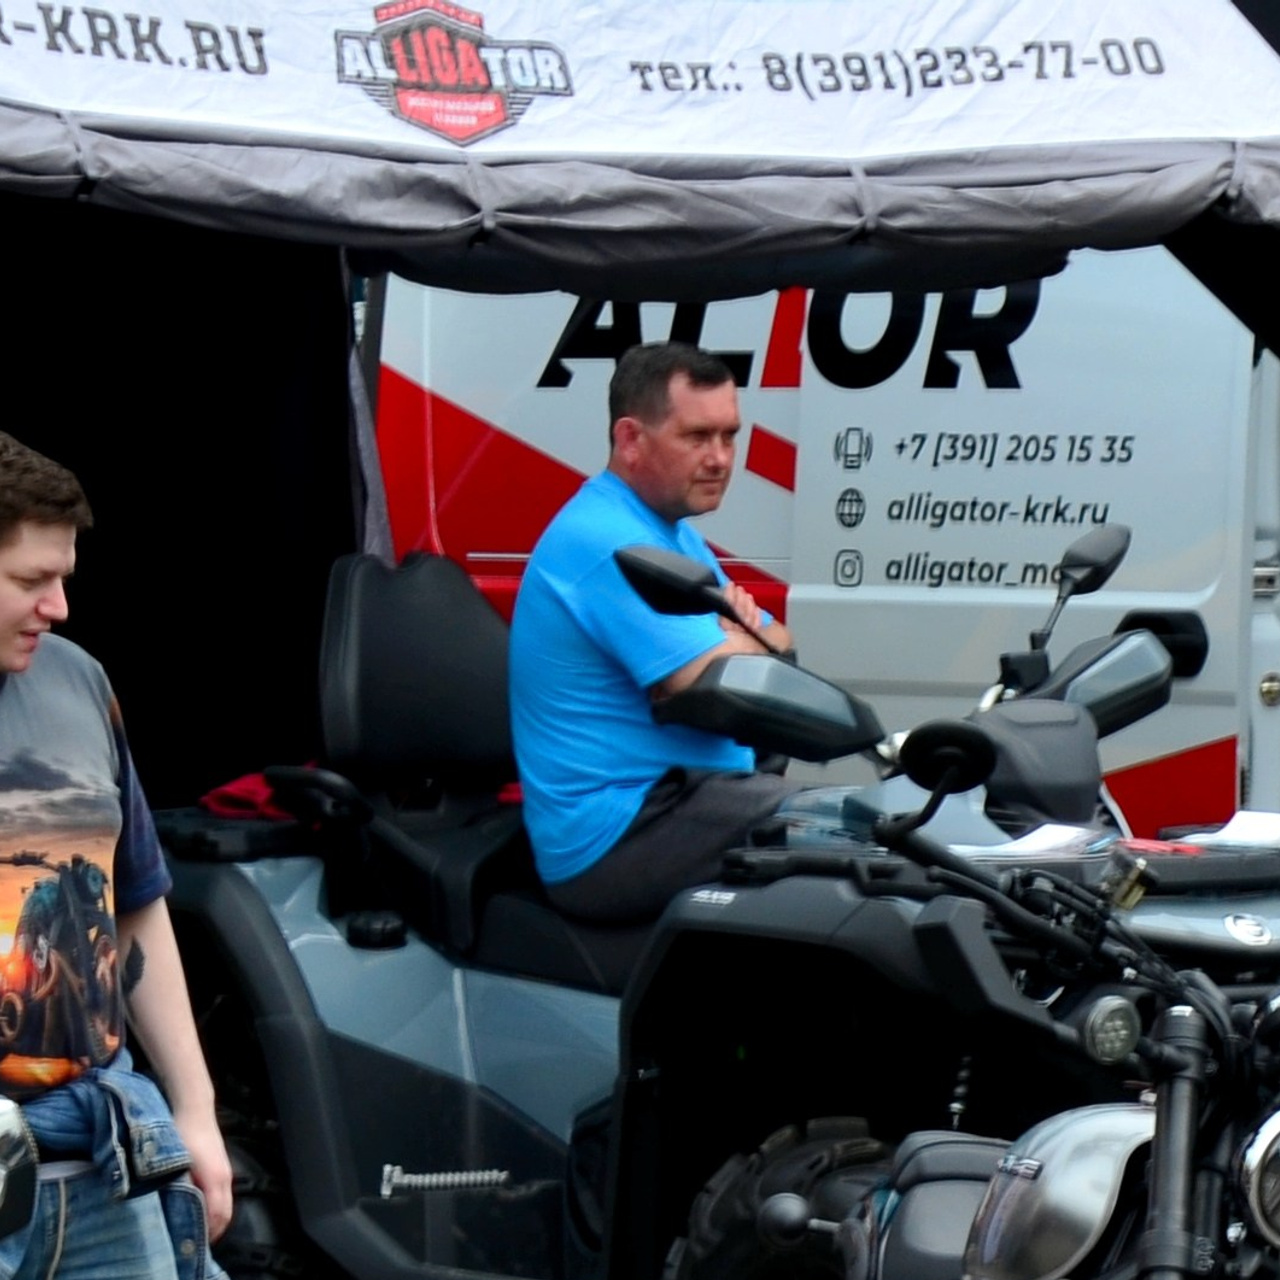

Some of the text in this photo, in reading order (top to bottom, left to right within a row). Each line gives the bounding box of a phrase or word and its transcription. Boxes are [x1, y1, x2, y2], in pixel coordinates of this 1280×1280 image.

[340, 24, 568, 91] ALLIGATOR
[762, 36, 1165, 100] 8(391)233-77-00
[894, 432, 927, 461] +7
[1005, 434, 1058, 462] 205
[1066, 435, 1093, 463] 15
[1100, 435, 1135, 464] 35
[886, 491, 1110, 529] alligator-krk.ru
